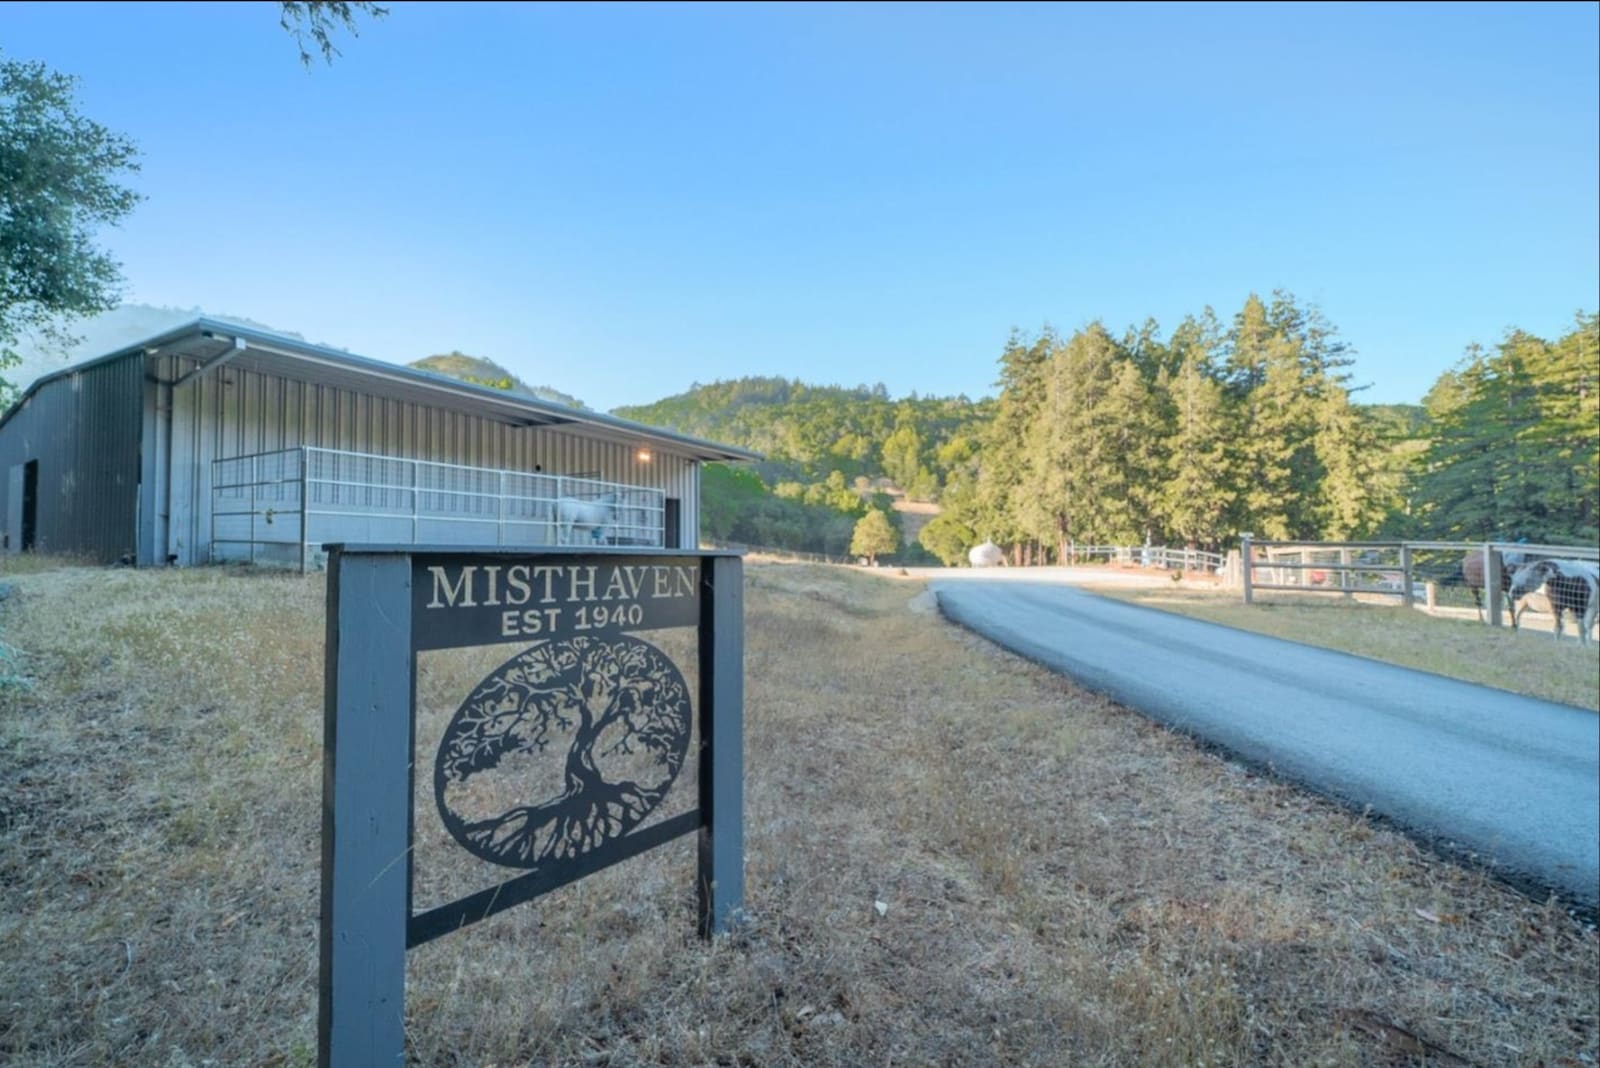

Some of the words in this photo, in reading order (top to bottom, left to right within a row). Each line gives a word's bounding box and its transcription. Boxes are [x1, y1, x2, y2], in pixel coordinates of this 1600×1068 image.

[426, 565, 698, 608] MISTHAVEN
[501, 608, 561, 636] EST
[574, 604, 643, 630] 1940
